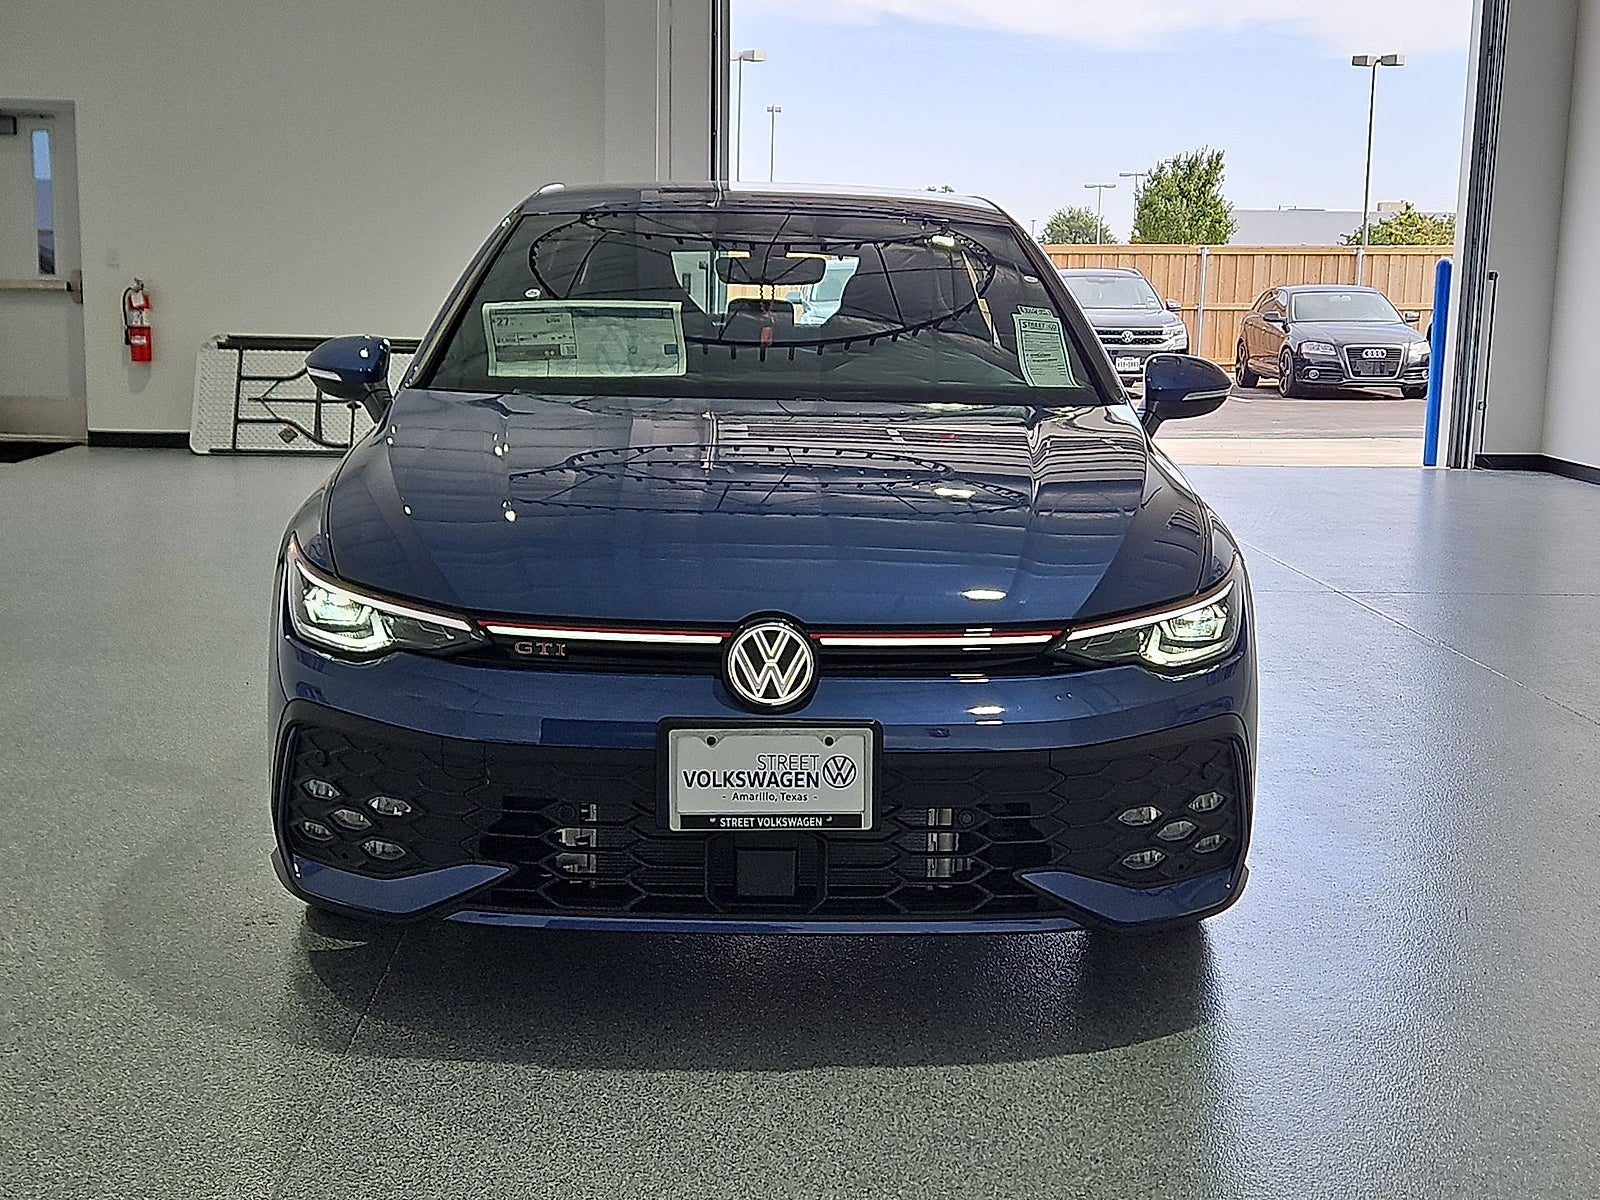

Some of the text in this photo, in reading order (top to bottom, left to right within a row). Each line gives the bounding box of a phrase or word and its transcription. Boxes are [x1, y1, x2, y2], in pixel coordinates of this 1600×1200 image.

[514, 640, 566, 657] GTI
[728, 623, 814, 706] VW
[757, 754, 820, 771] STREET
[682, 770, 820, 789] VOLKSWAGEN
[732, 792, 808, 802] Amarillo, Texas
[719, 816, 823, 827] STREET VOLKSWAGEN
